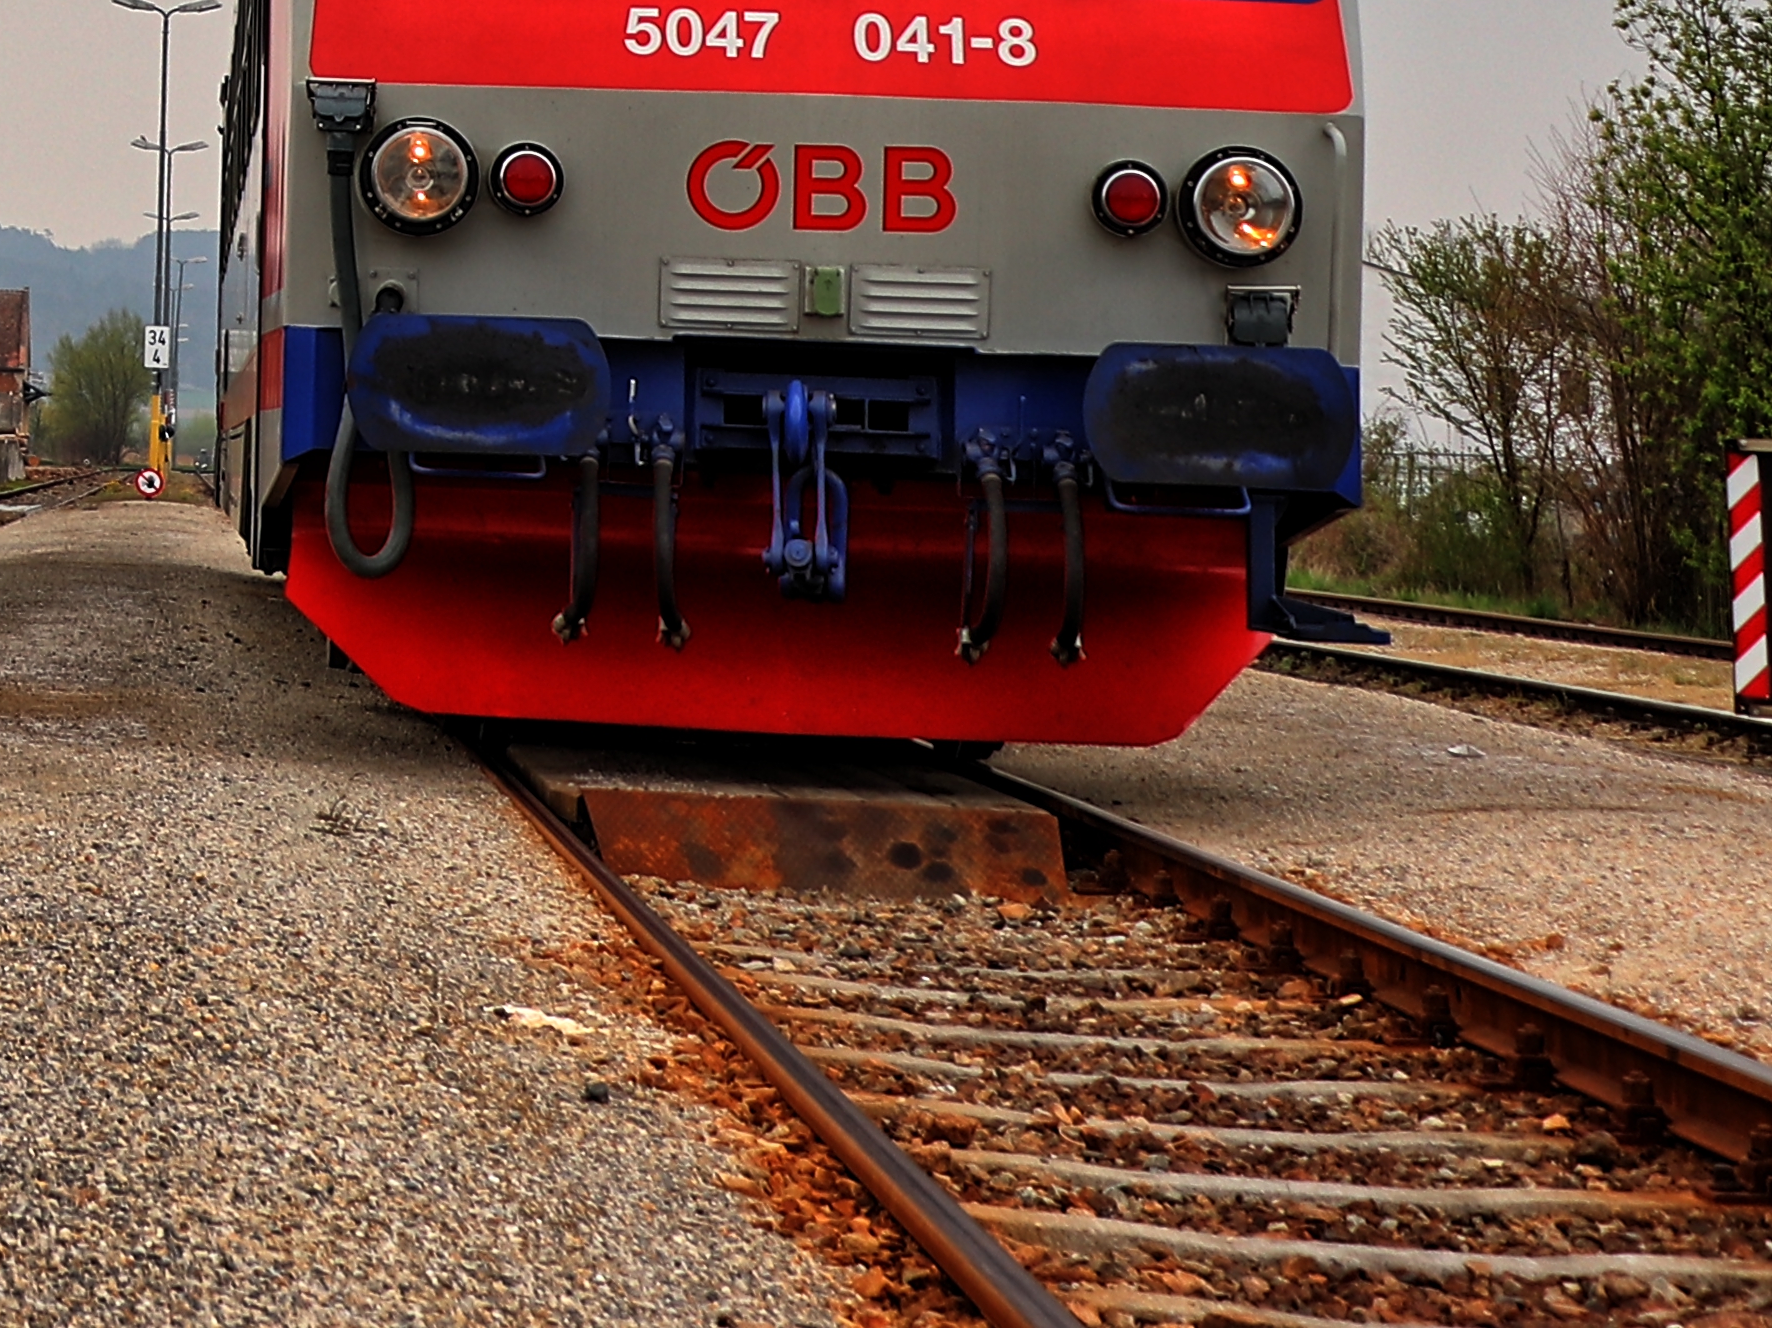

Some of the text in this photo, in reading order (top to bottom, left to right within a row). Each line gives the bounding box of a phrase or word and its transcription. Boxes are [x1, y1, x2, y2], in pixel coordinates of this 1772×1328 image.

[623, 7, 1038, 67] 5047 041-8
[686, 139, 958, 233] ÖBB
[148, 330, 166, 345] 34
[152, 349, 160, 364] 4
